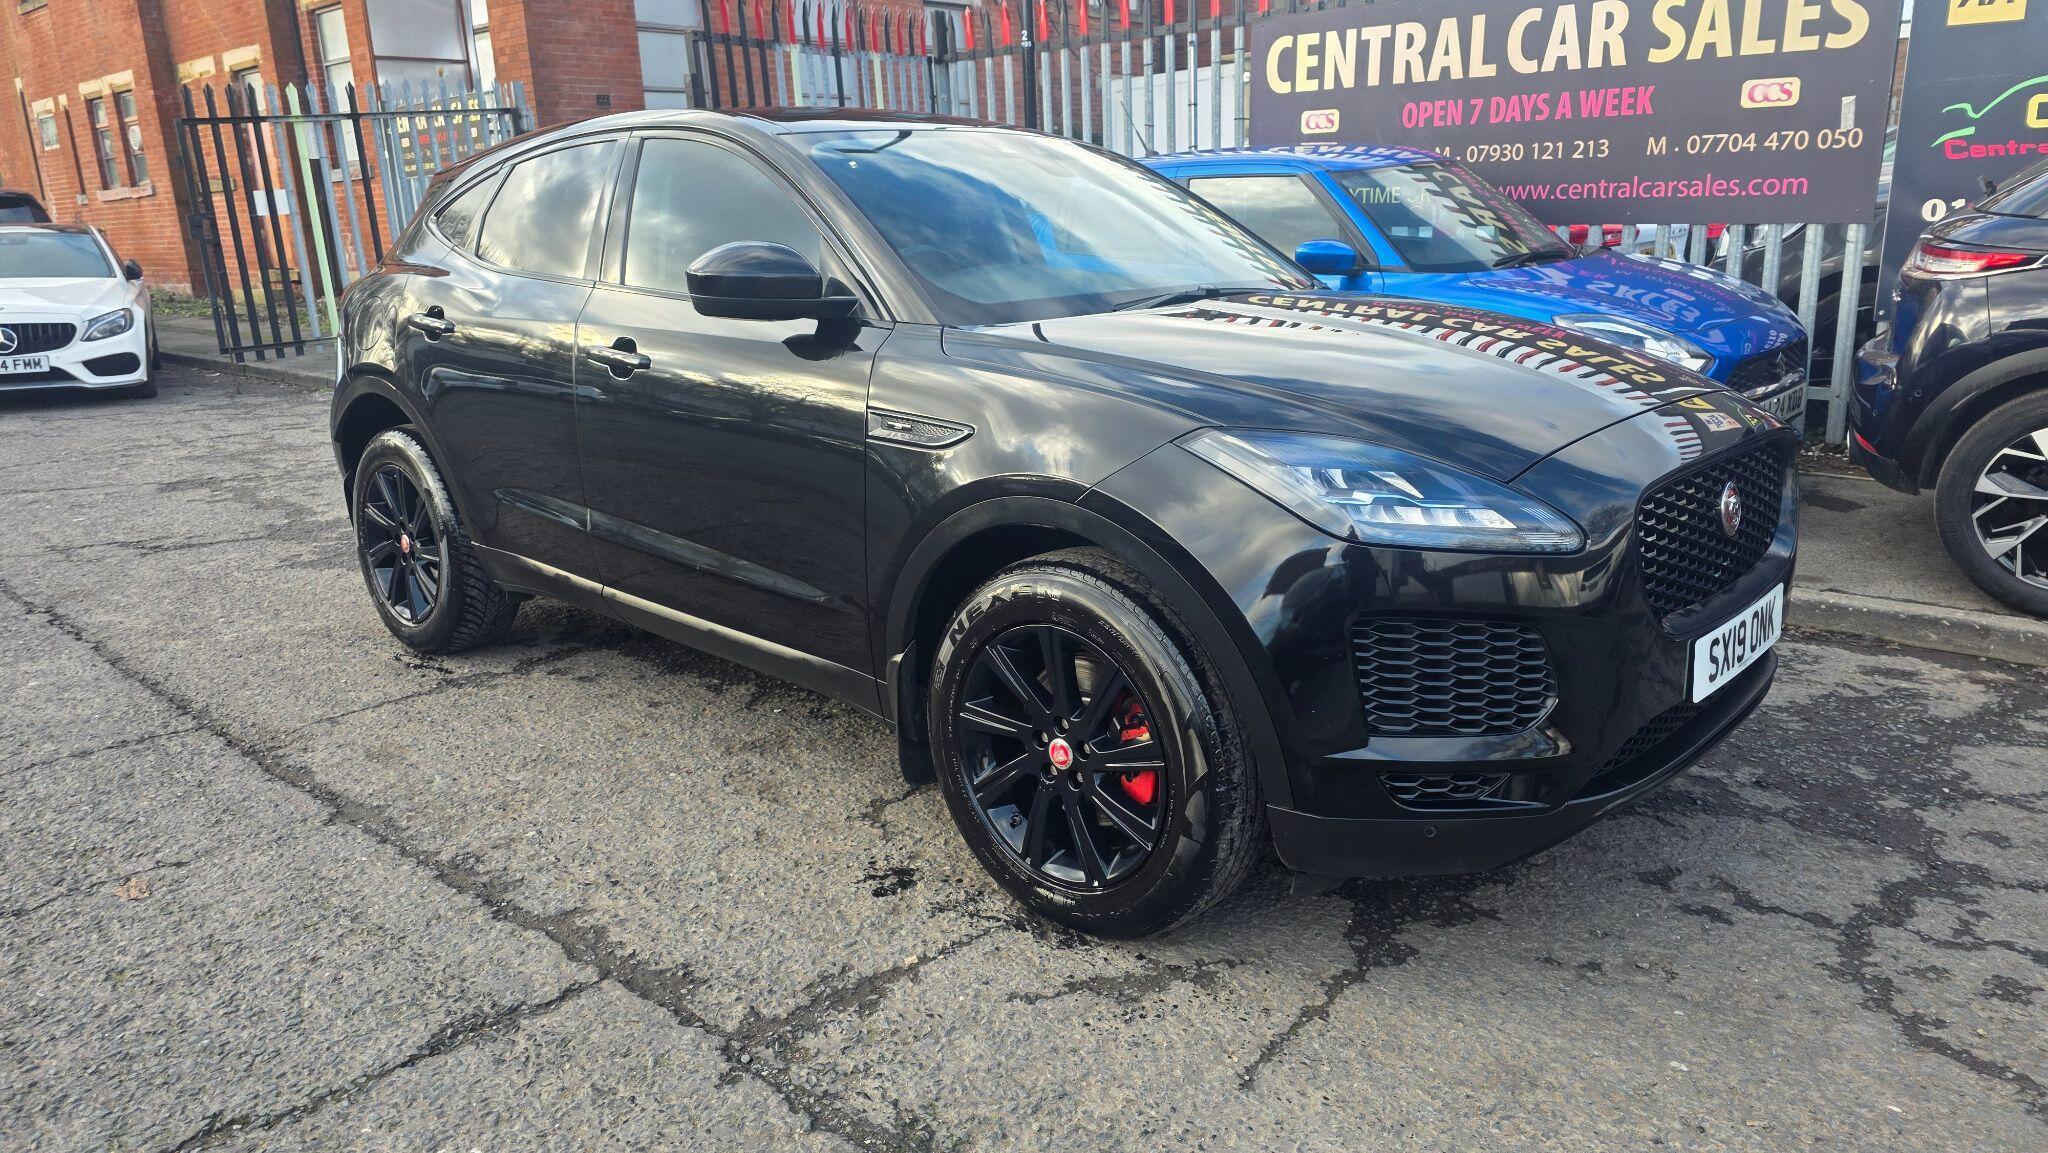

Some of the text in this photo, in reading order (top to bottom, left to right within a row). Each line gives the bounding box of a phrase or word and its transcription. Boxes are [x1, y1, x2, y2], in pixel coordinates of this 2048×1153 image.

[1265, 0, 1870, 94] CENTRAL CAR SALES
[1402, 85, 1657, 129] OPEN 7 DAYS A WEEK
[1747, 82, 1793, 104] CCS
[1305, 112, 1335, 131] CCS
[1466, 143, 1524, 163] 07930
[1532, 141, 1563, 160] 121
[1572, 139, 1610, 159] 213
[1646, 136, 1666, 156] M
[1687, 132, 1756, 155] 07704
[1763, 130, 1809, 152] 470
[1817, 127, 1864, 150] 050
[12, 357, 43, 371] FMM
[948, 583, 1062, 648] NEXEN
[1708, 595, 1777, 683] SX19 ONK
